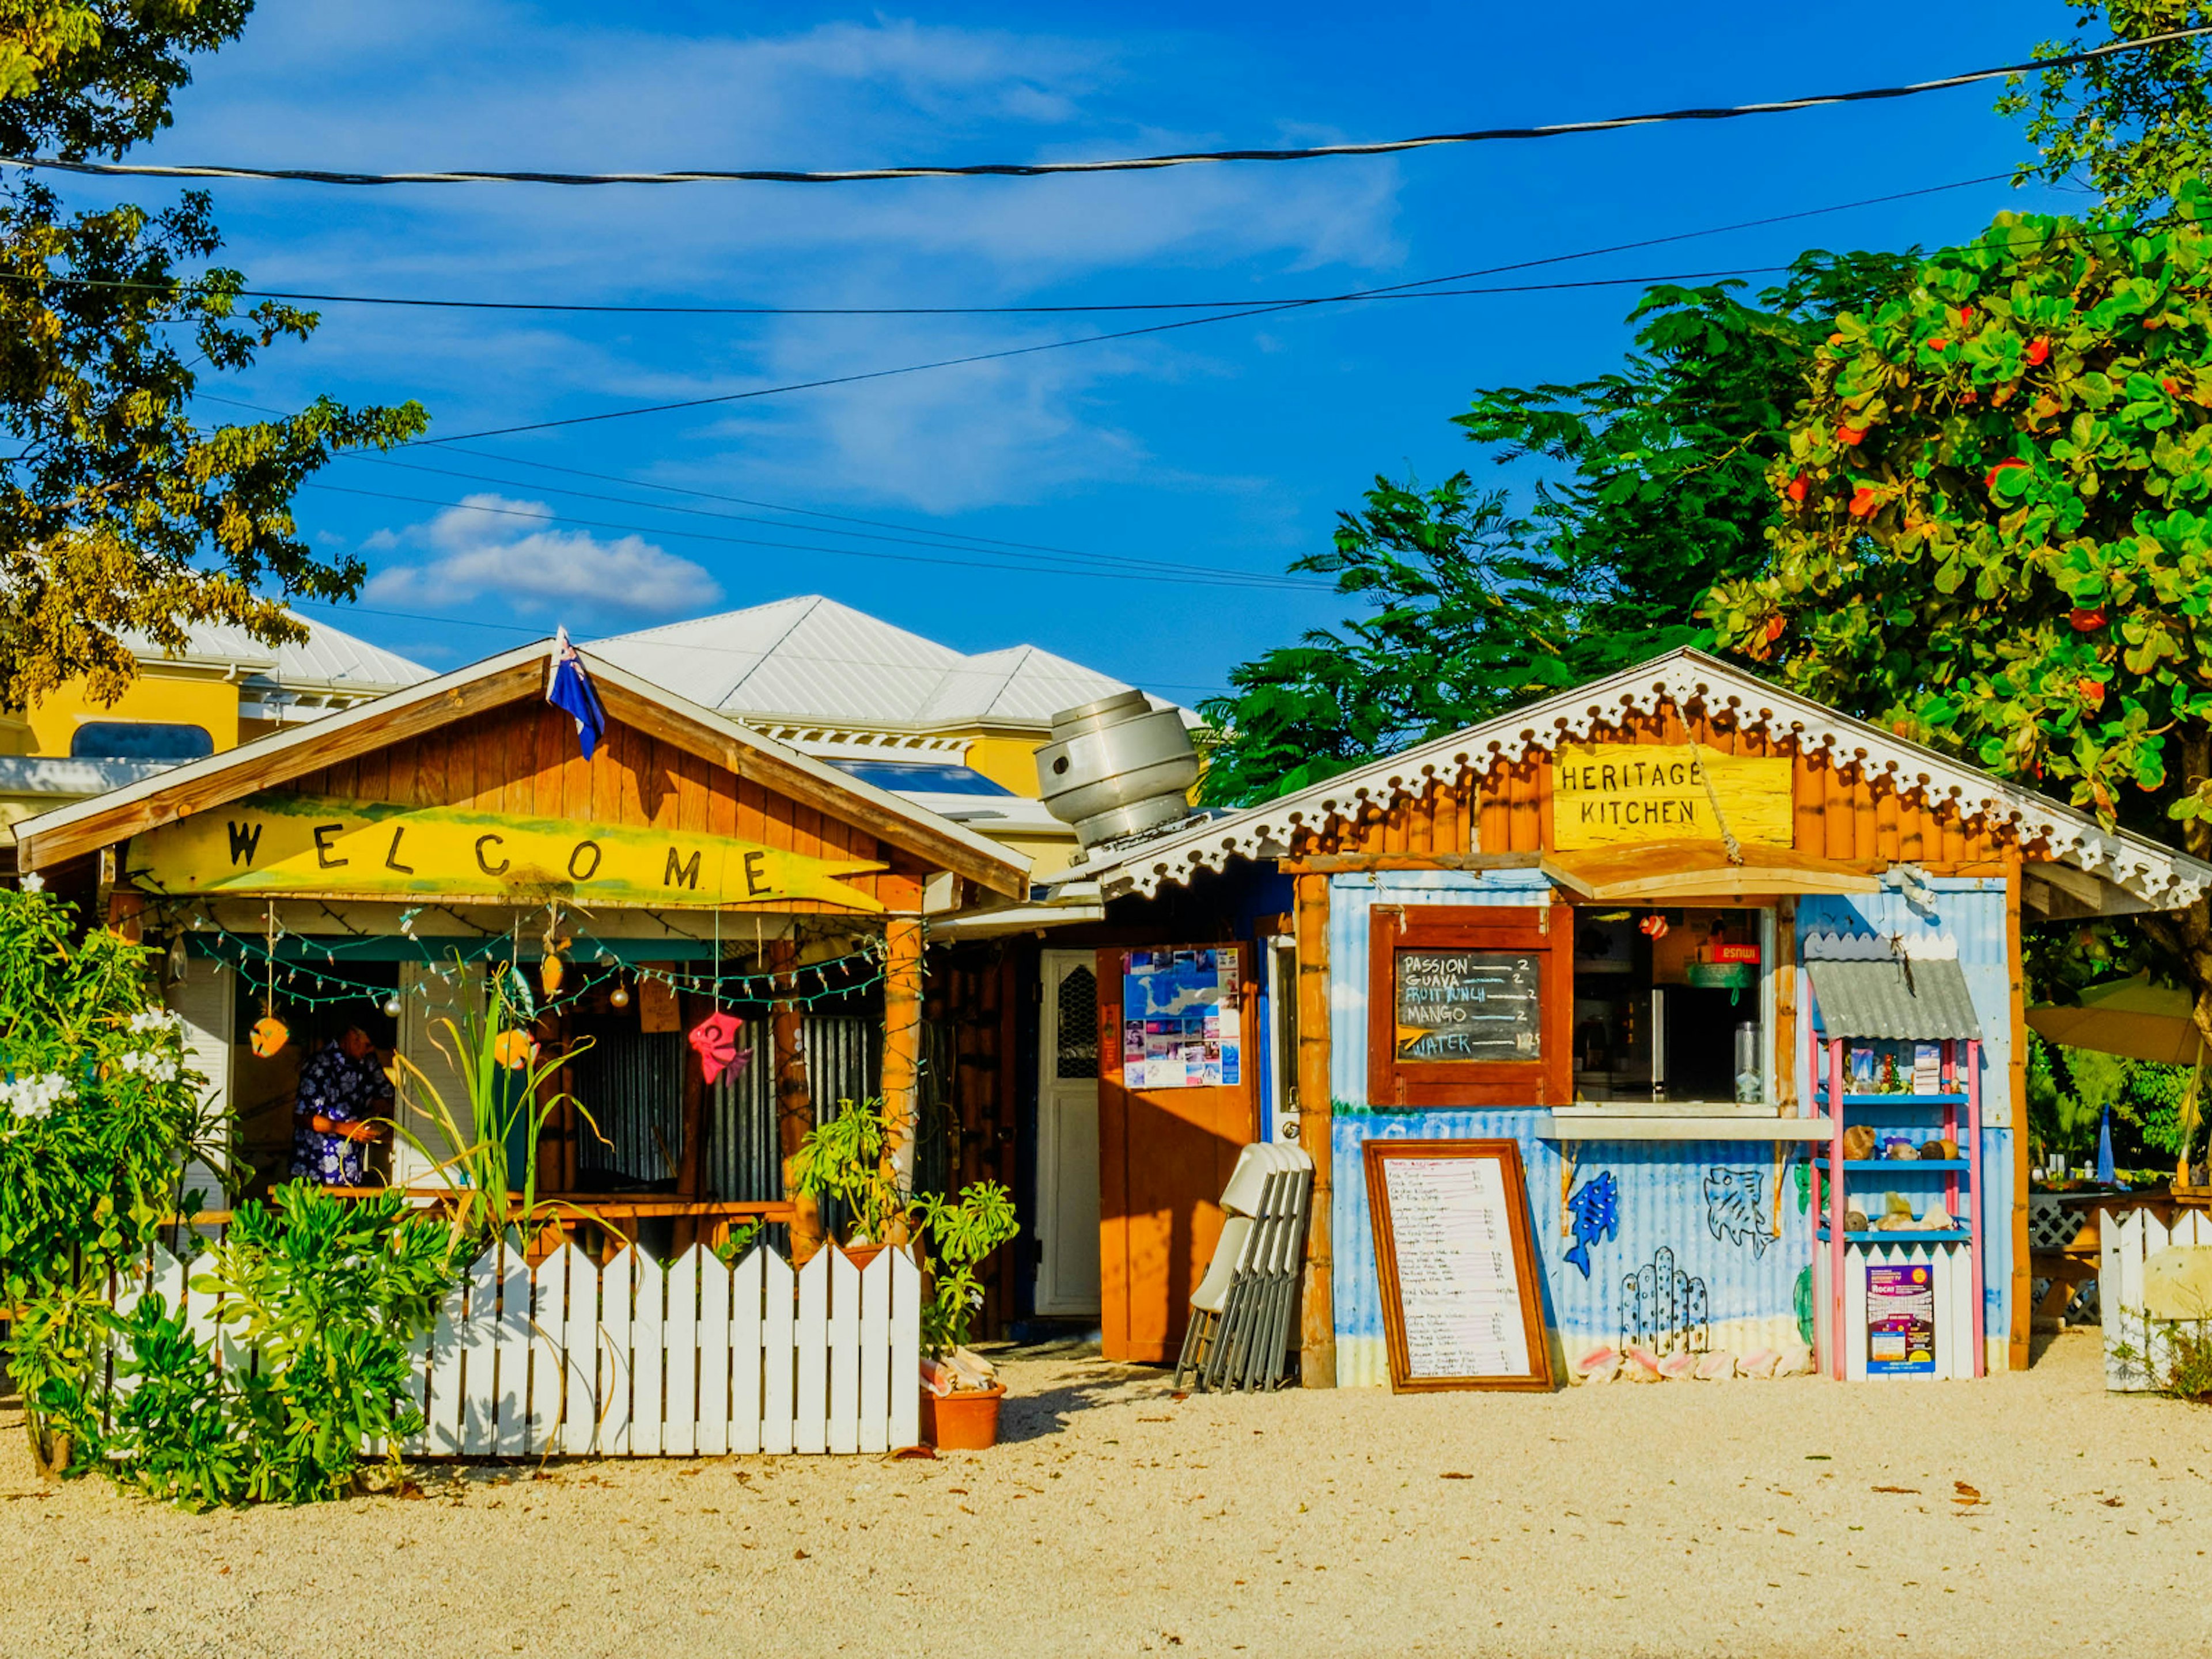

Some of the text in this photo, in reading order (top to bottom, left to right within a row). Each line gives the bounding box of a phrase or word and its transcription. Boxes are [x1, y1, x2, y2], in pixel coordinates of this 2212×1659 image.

[1562, 761, 1703, 791] HERITAGE
[1581, 800, 1694, 824] KITCHEN
[228, 820, 772, 896] WELCOME
[1403, 956, 1530, 975] PASSION 2
[1405, 972, 1524, 987] GUAVA 2
[1405, 986, 1443, 1004] FRUIT
[1528, 988, 1537, 1001] 2
[1407, 1005, 1528, 1024] MANGO 2
[1413, 1033, 1472, 1056] WATER
